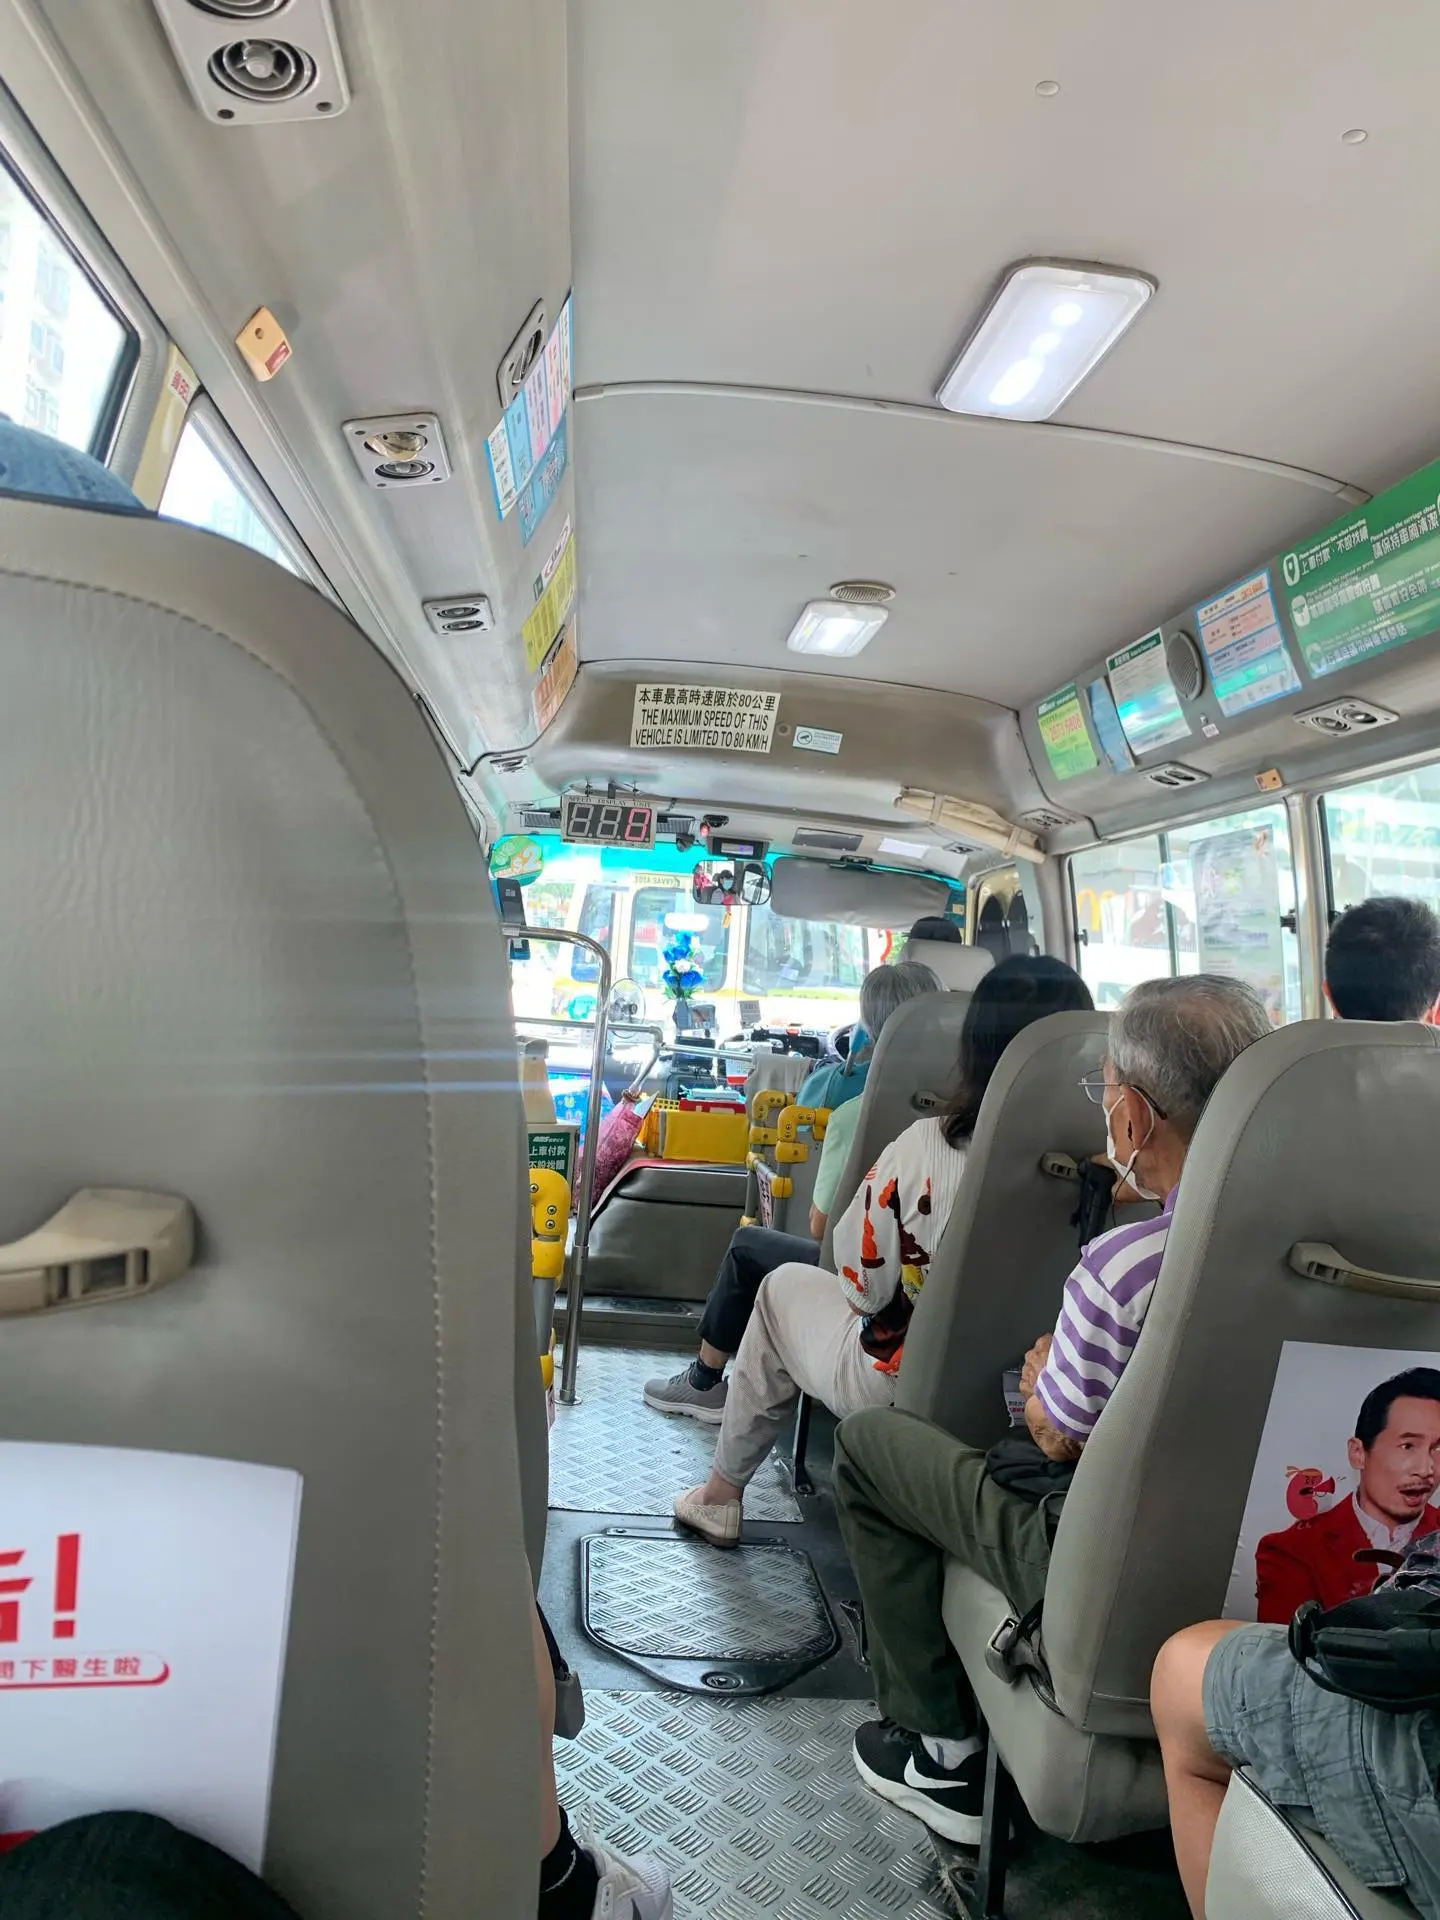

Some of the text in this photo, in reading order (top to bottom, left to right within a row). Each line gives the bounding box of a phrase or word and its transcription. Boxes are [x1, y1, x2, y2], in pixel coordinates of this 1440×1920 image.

[639, 687, 776, 712] 本車最高時速限於80公里
[641, 709, 769, 731] THE MAXIMUM SPEED OF THIS
[635, 728, 768, 751] VEHICLE IS LIMITED TO 80 KM/H
[529, 1146, 566, 1156] 上車付款
